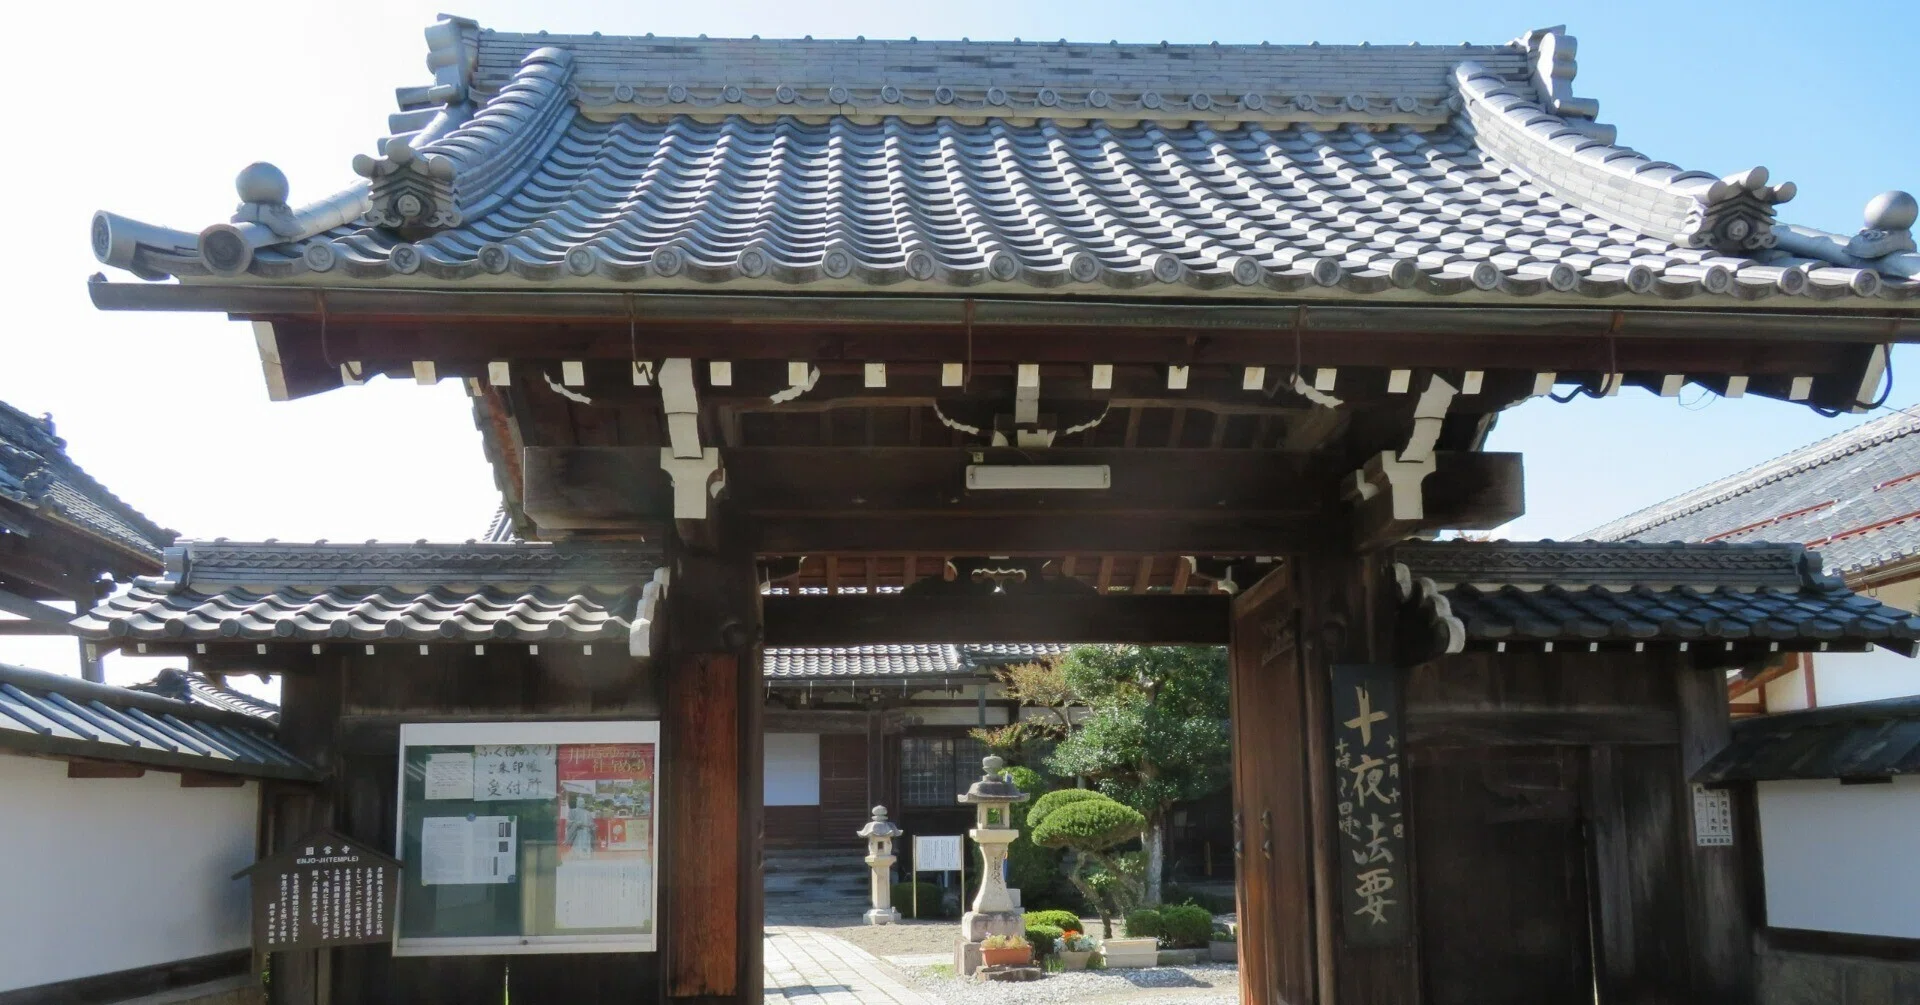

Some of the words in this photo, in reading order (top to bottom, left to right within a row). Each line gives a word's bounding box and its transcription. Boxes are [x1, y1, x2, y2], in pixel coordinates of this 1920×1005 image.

[487, 777, 542, 796] 受付所
[1343, 682, 1398, 927] 十夜法要
